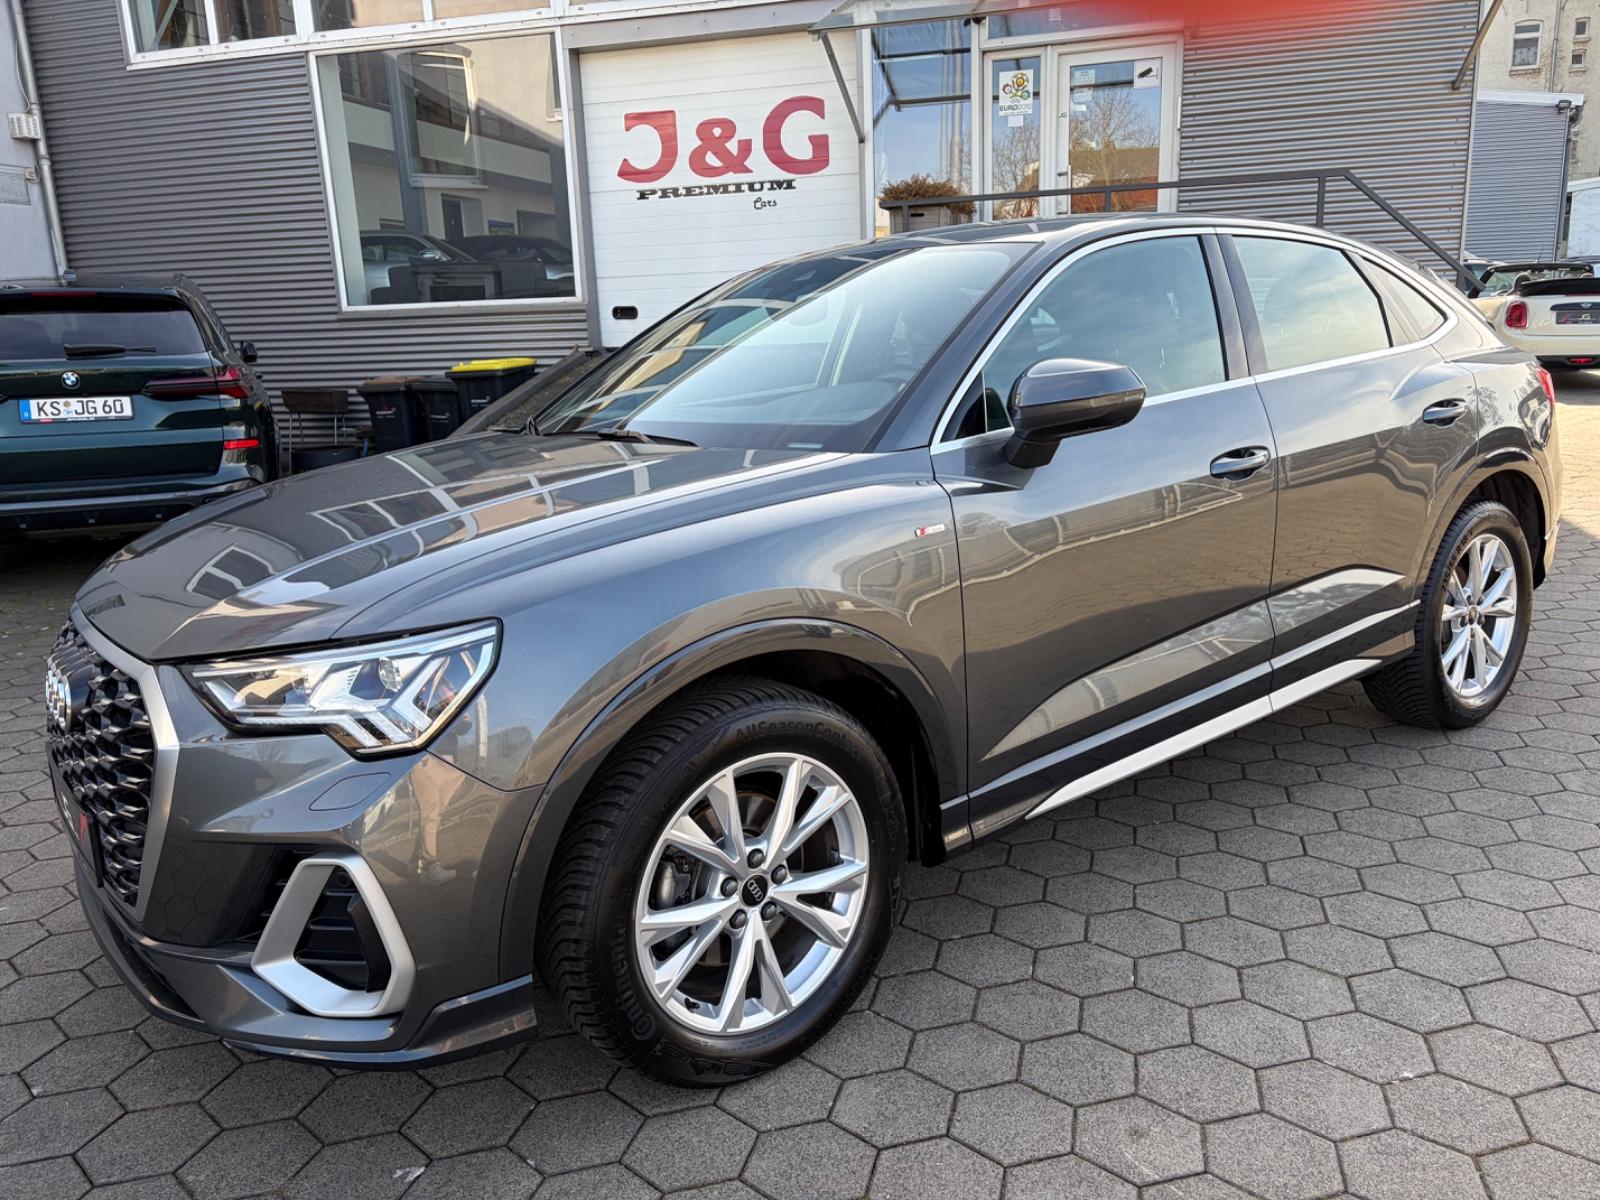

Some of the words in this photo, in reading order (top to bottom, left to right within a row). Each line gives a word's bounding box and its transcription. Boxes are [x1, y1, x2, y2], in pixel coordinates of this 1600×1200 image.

[617, 95, 830, 183] J&G
[636, 178, 796, 200] PREMIUM
[753, 196, 778, 209] Cars
[37, 401, 61, 417] KS
[74, 400, 97, 416] JG
[102, 399, 124, 415] 60
